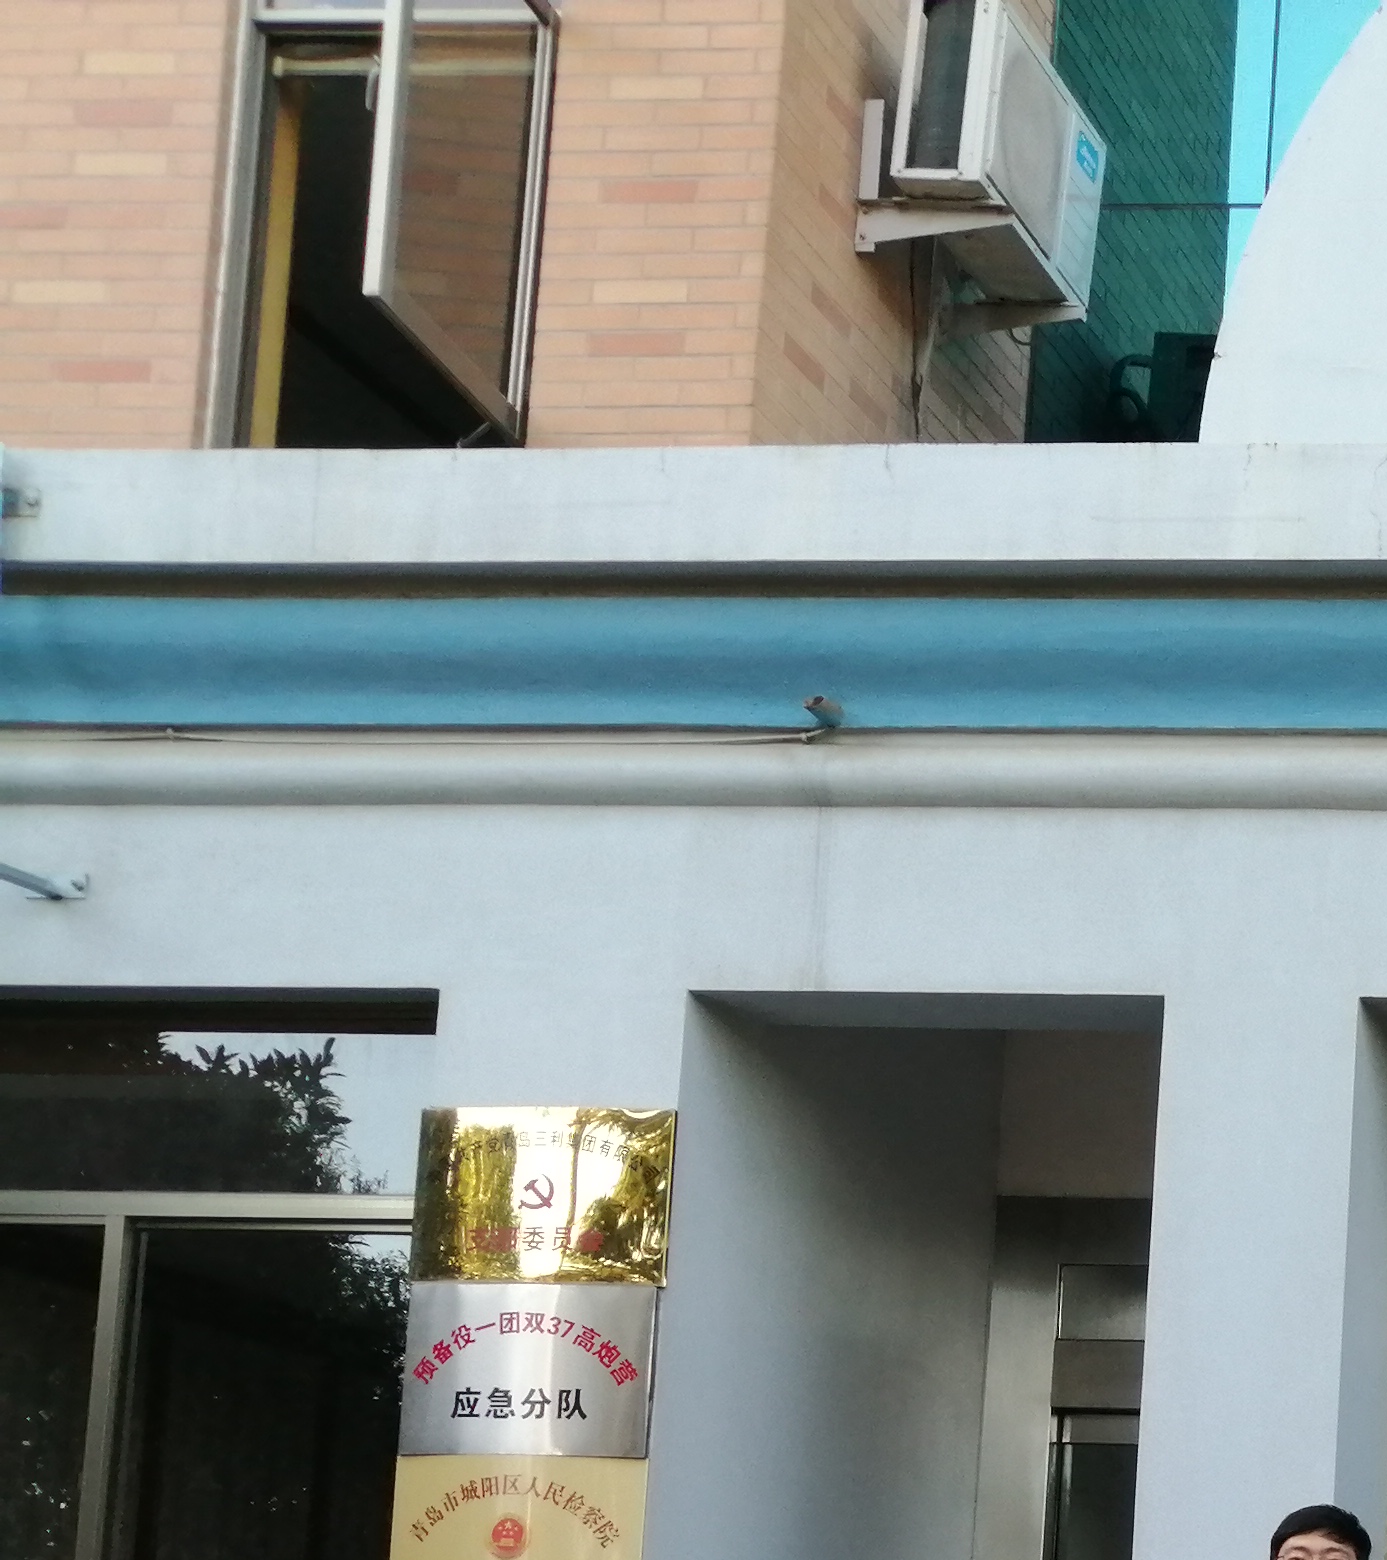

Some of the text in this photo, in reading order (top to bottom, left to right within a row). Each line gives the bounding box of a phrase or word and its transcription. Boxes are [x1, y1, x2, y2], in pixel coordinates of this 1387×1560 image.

[412, 1312, 639, 1386] 预备役一团双37高炮营
[450, 1387, 588, 1420] 应急分队
[409, 1474, 621, 1549] 青岛市城阳区人民检察院
